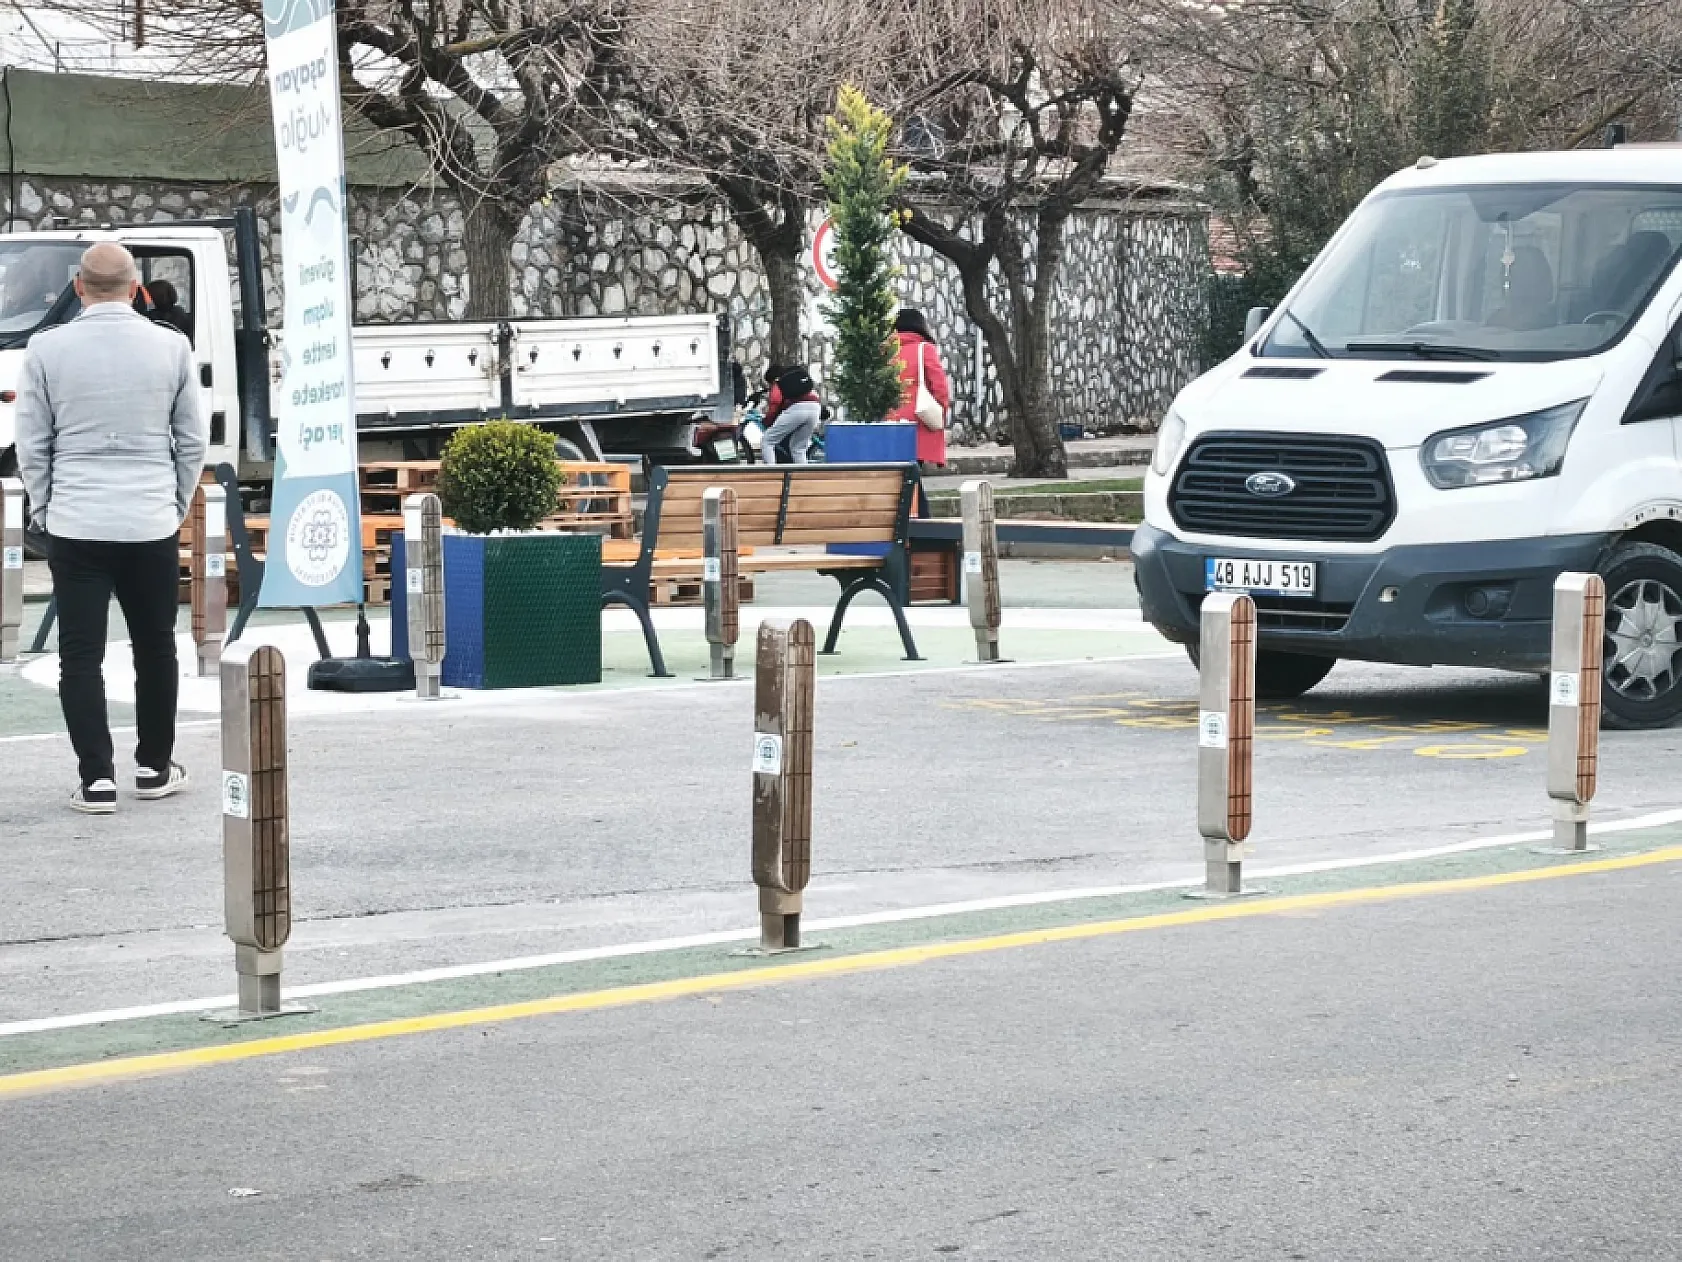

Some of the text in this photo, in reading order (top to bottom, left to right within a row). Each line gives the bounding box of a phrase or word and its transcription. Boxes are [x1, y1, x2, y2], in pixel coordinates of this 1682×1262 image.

[1215, 560, 1312, 588] 48 AJJ 519
